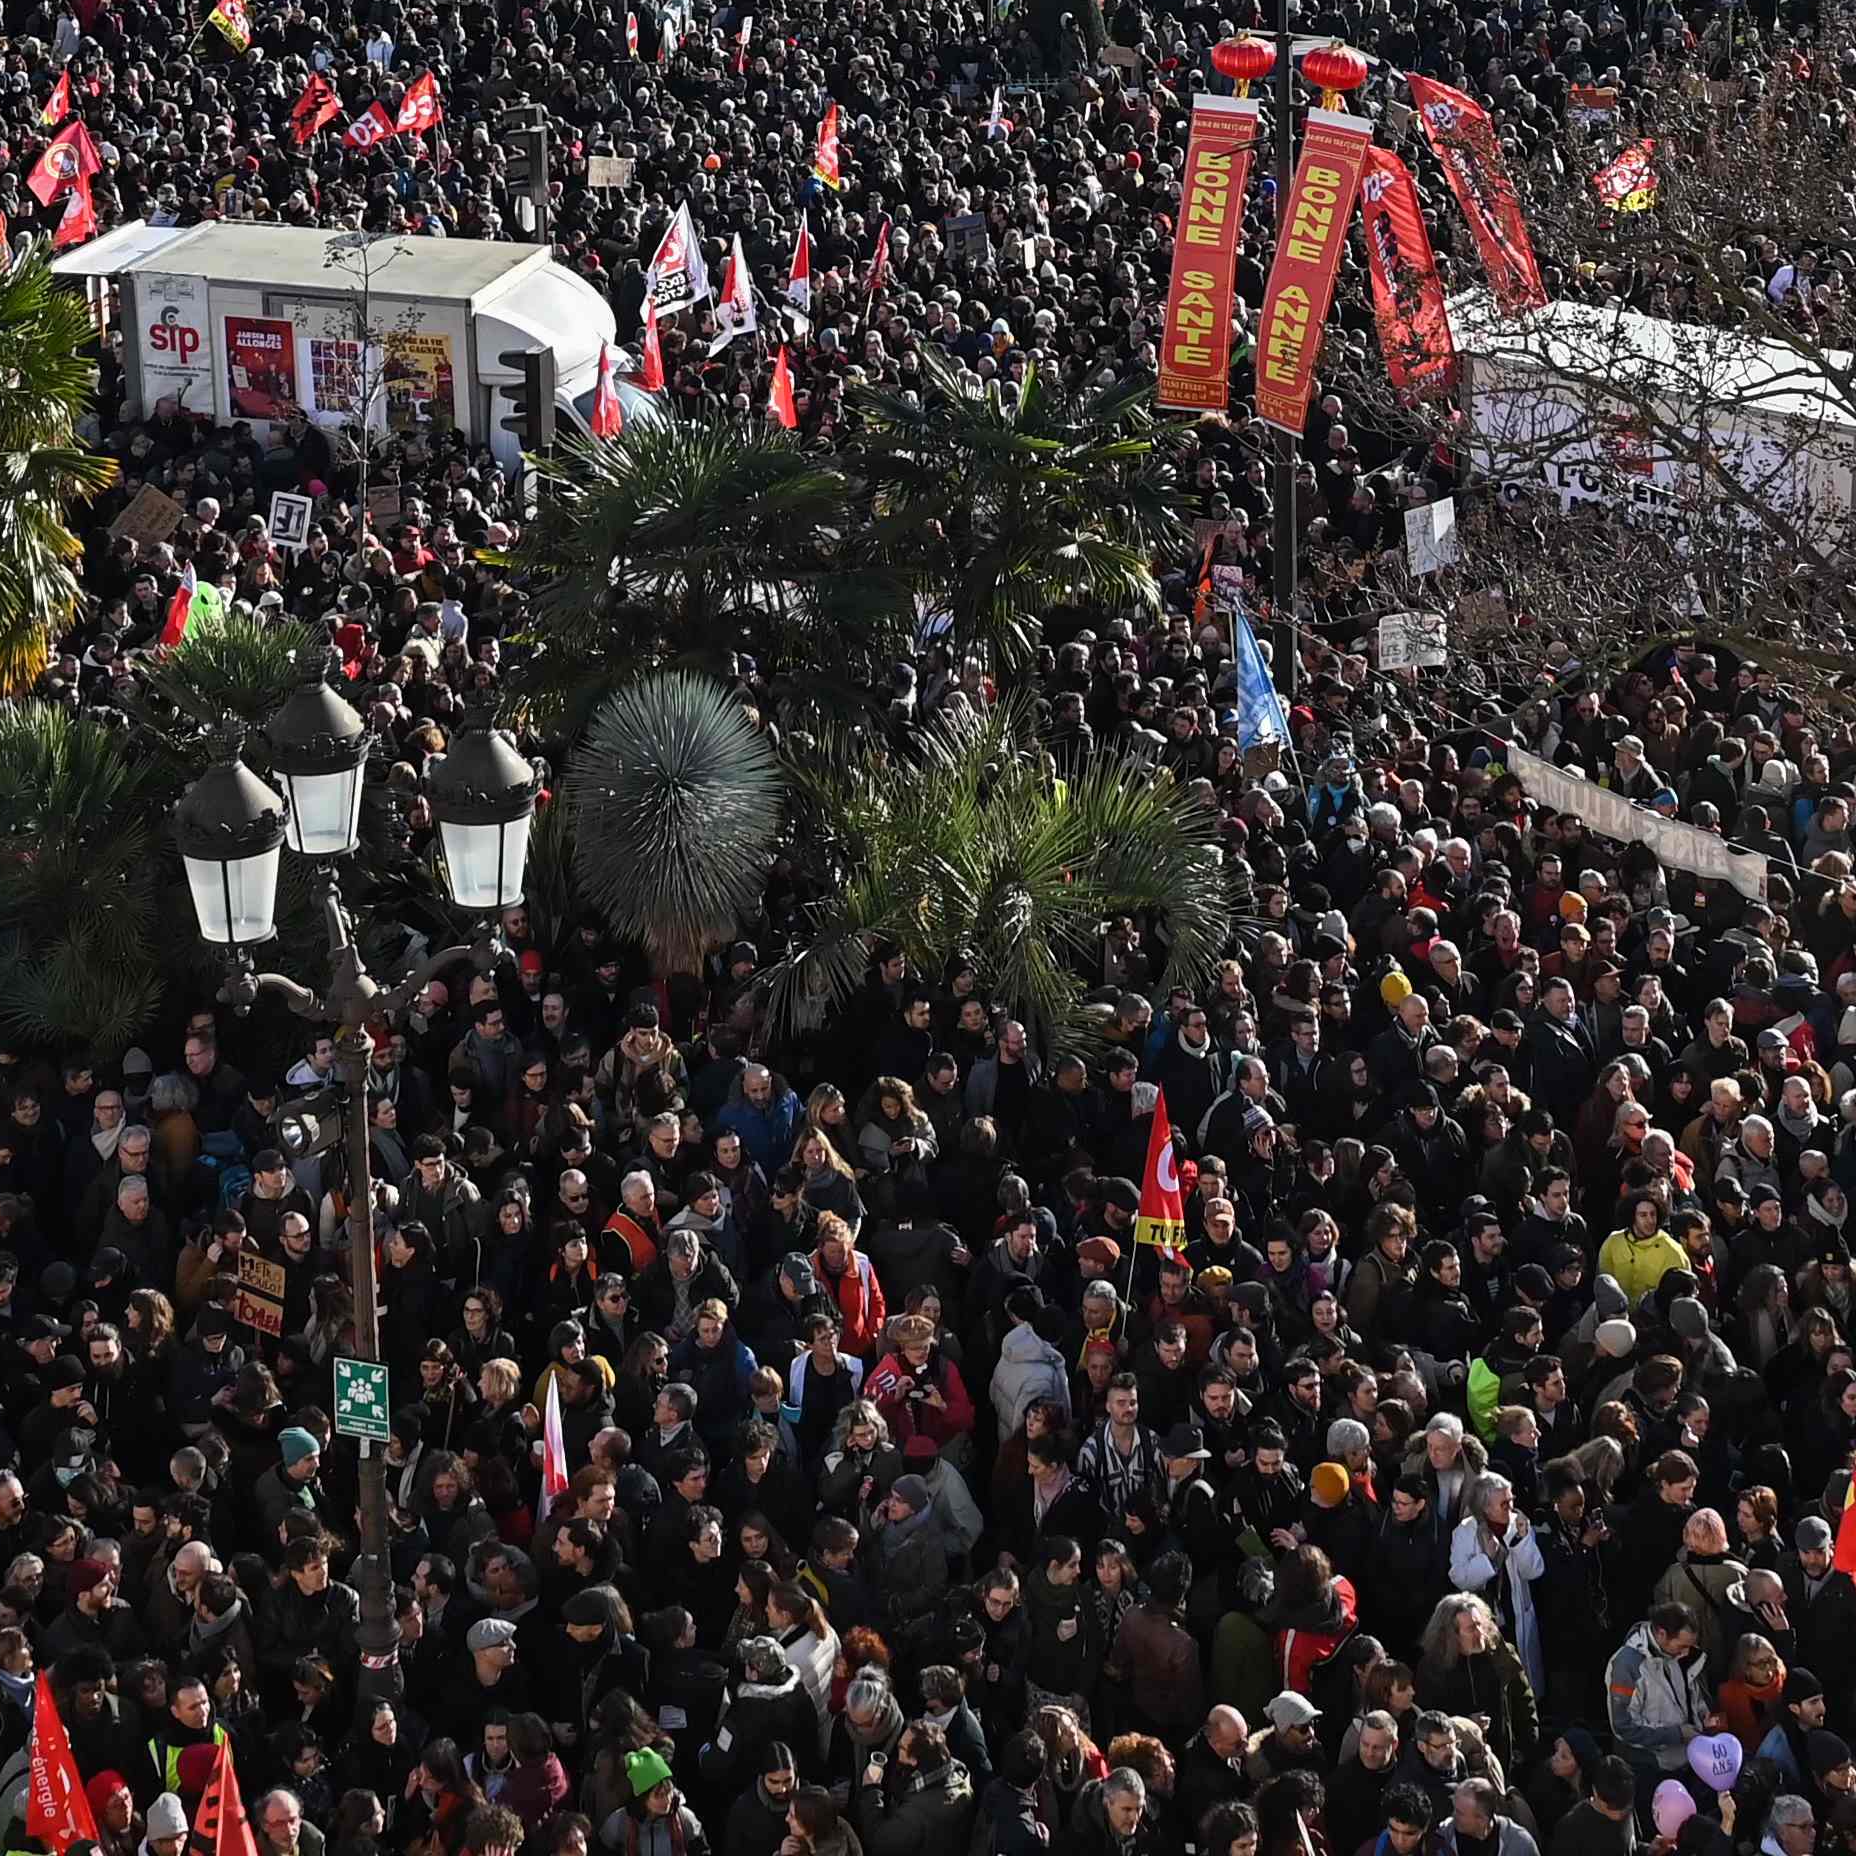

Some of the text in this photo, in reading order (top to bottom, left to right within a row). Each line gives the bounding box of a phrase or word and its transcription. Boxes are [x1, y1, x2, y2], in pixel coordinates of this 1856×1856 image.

[1186, 151, 1233, 246] BONNE
[1285, 165, 1342, 264] BONNE
[1174, 271, 1217, 367] SANTE
[1265, 285, 1311, 385] ANNEE
[1712, 1743, 1727, 1760] 60
[1712, 1760, 1734, 1776] ANS
